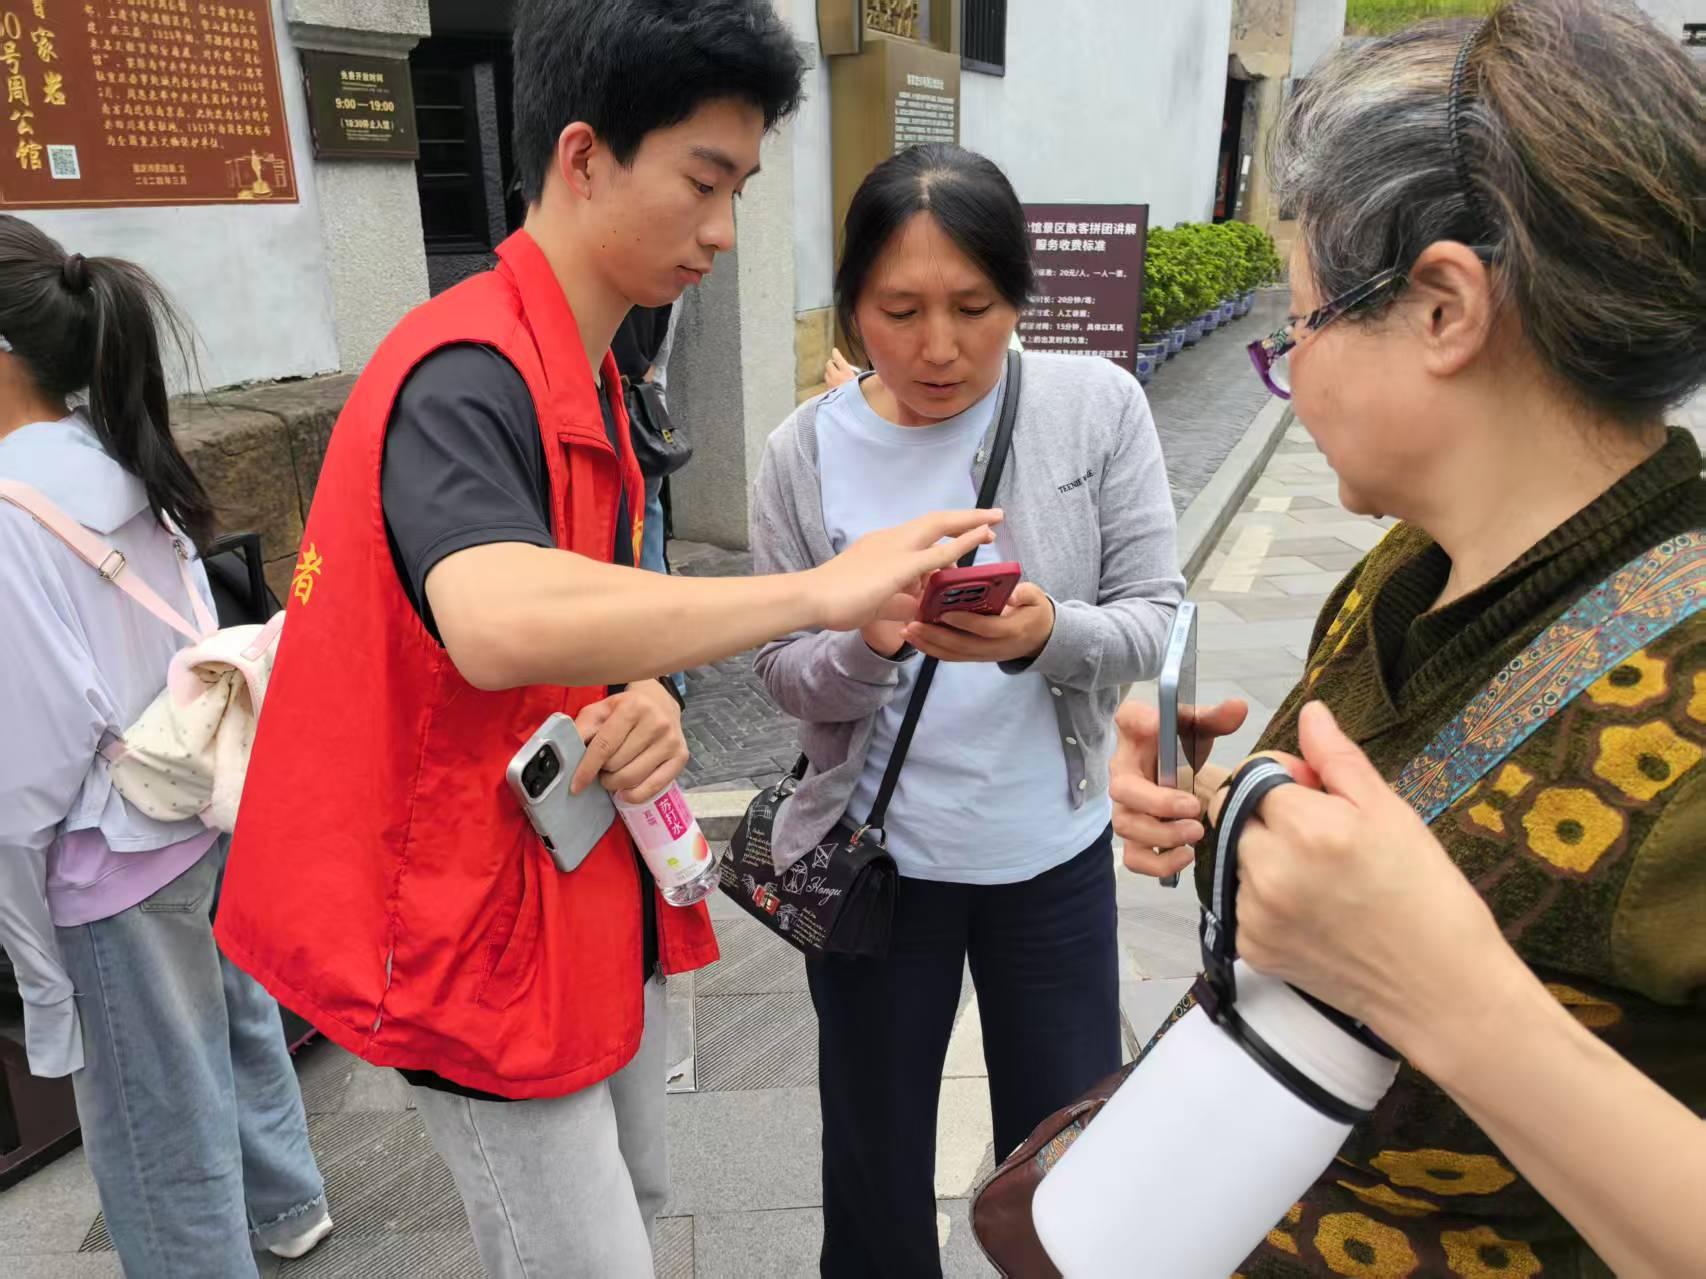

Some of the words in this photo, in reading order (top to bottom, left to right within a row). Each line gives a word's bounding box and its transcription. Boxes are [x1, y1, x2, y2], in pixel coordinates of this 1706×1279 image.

[0, 11, 43, 170] 0号周公馆
[1025, 221, 1137, 236] 馆景区散客拼团讲解
[1035, 238, 1106, 251] 服务收费标准
[291, 541, 323, 606] 者
[659, 798, 684, 836] 苏打水
